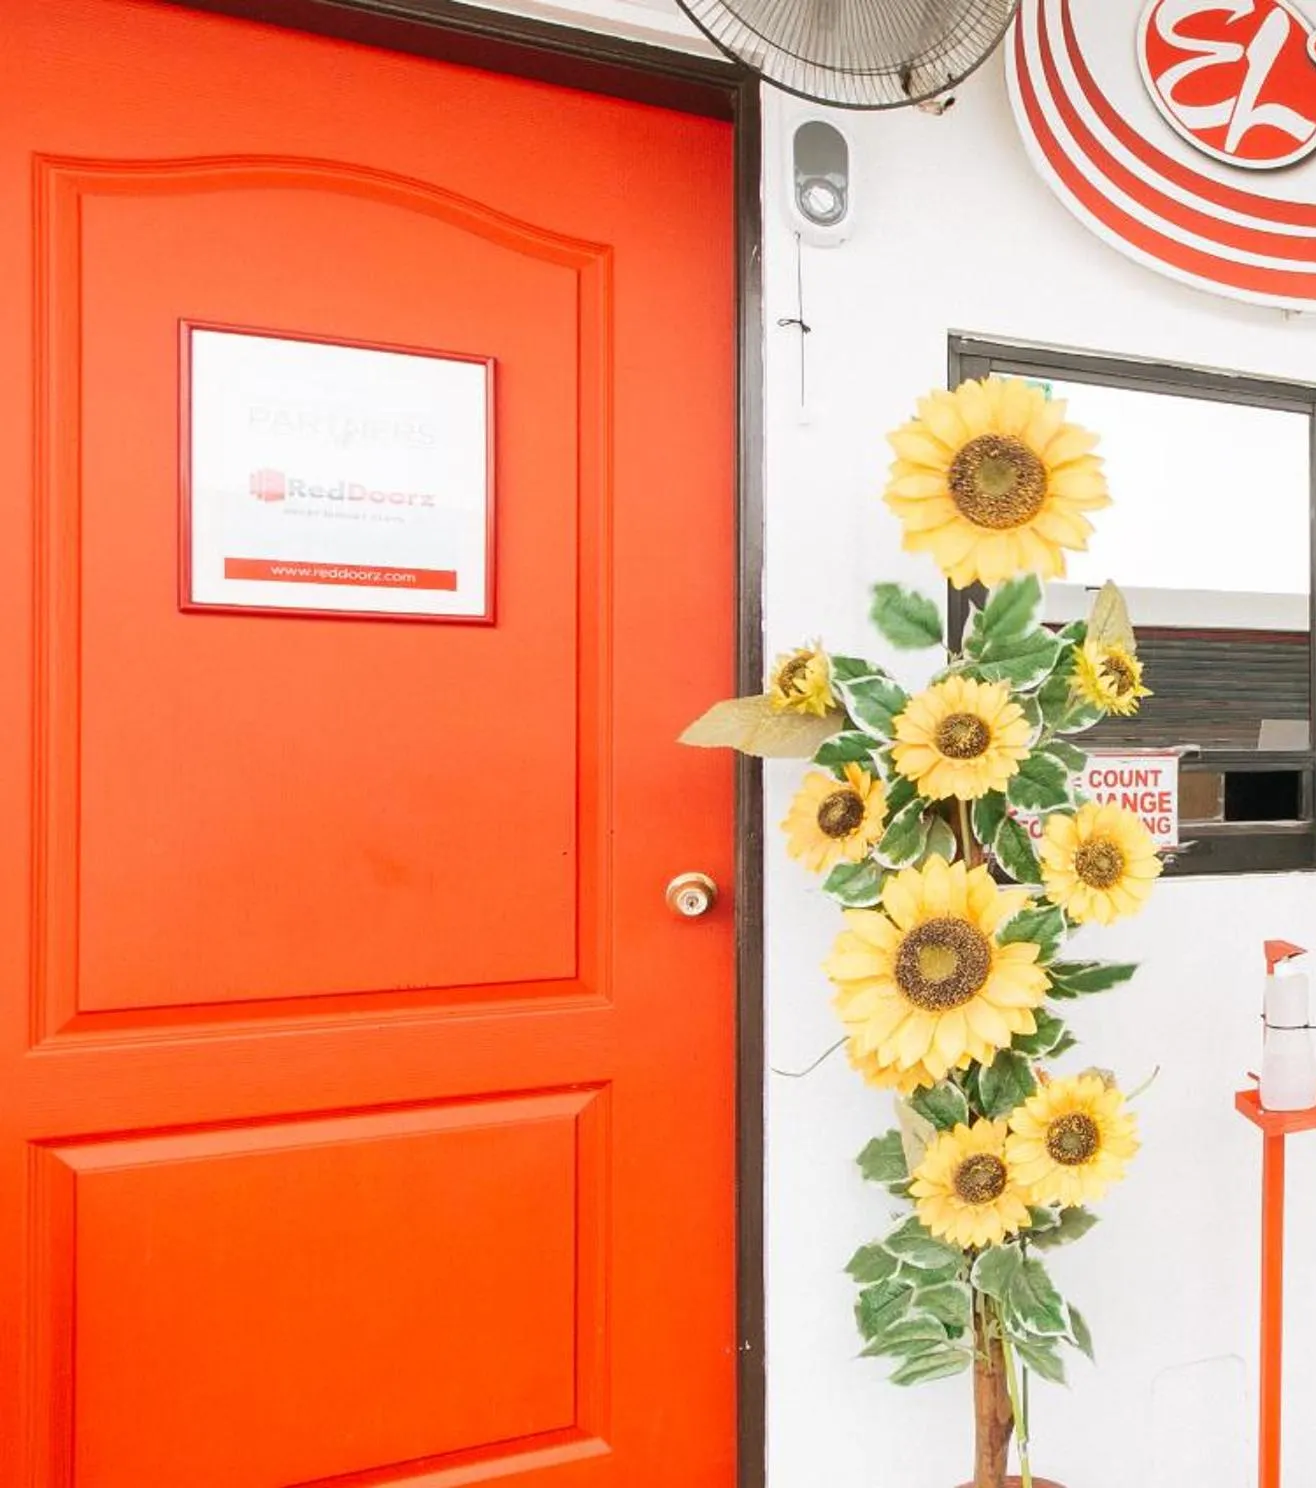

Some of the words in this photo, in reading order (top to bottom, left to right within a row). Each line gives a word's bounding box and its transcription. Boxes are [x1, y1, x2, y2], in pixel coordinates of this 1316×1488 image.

[288, 477, 437, 508] RedDoorz
[270, 565, 417, 583] www.reddoorz.com
[1088, 769, 1163, 789] COUNT
[1095, 791, 1173, 814] ANGE
